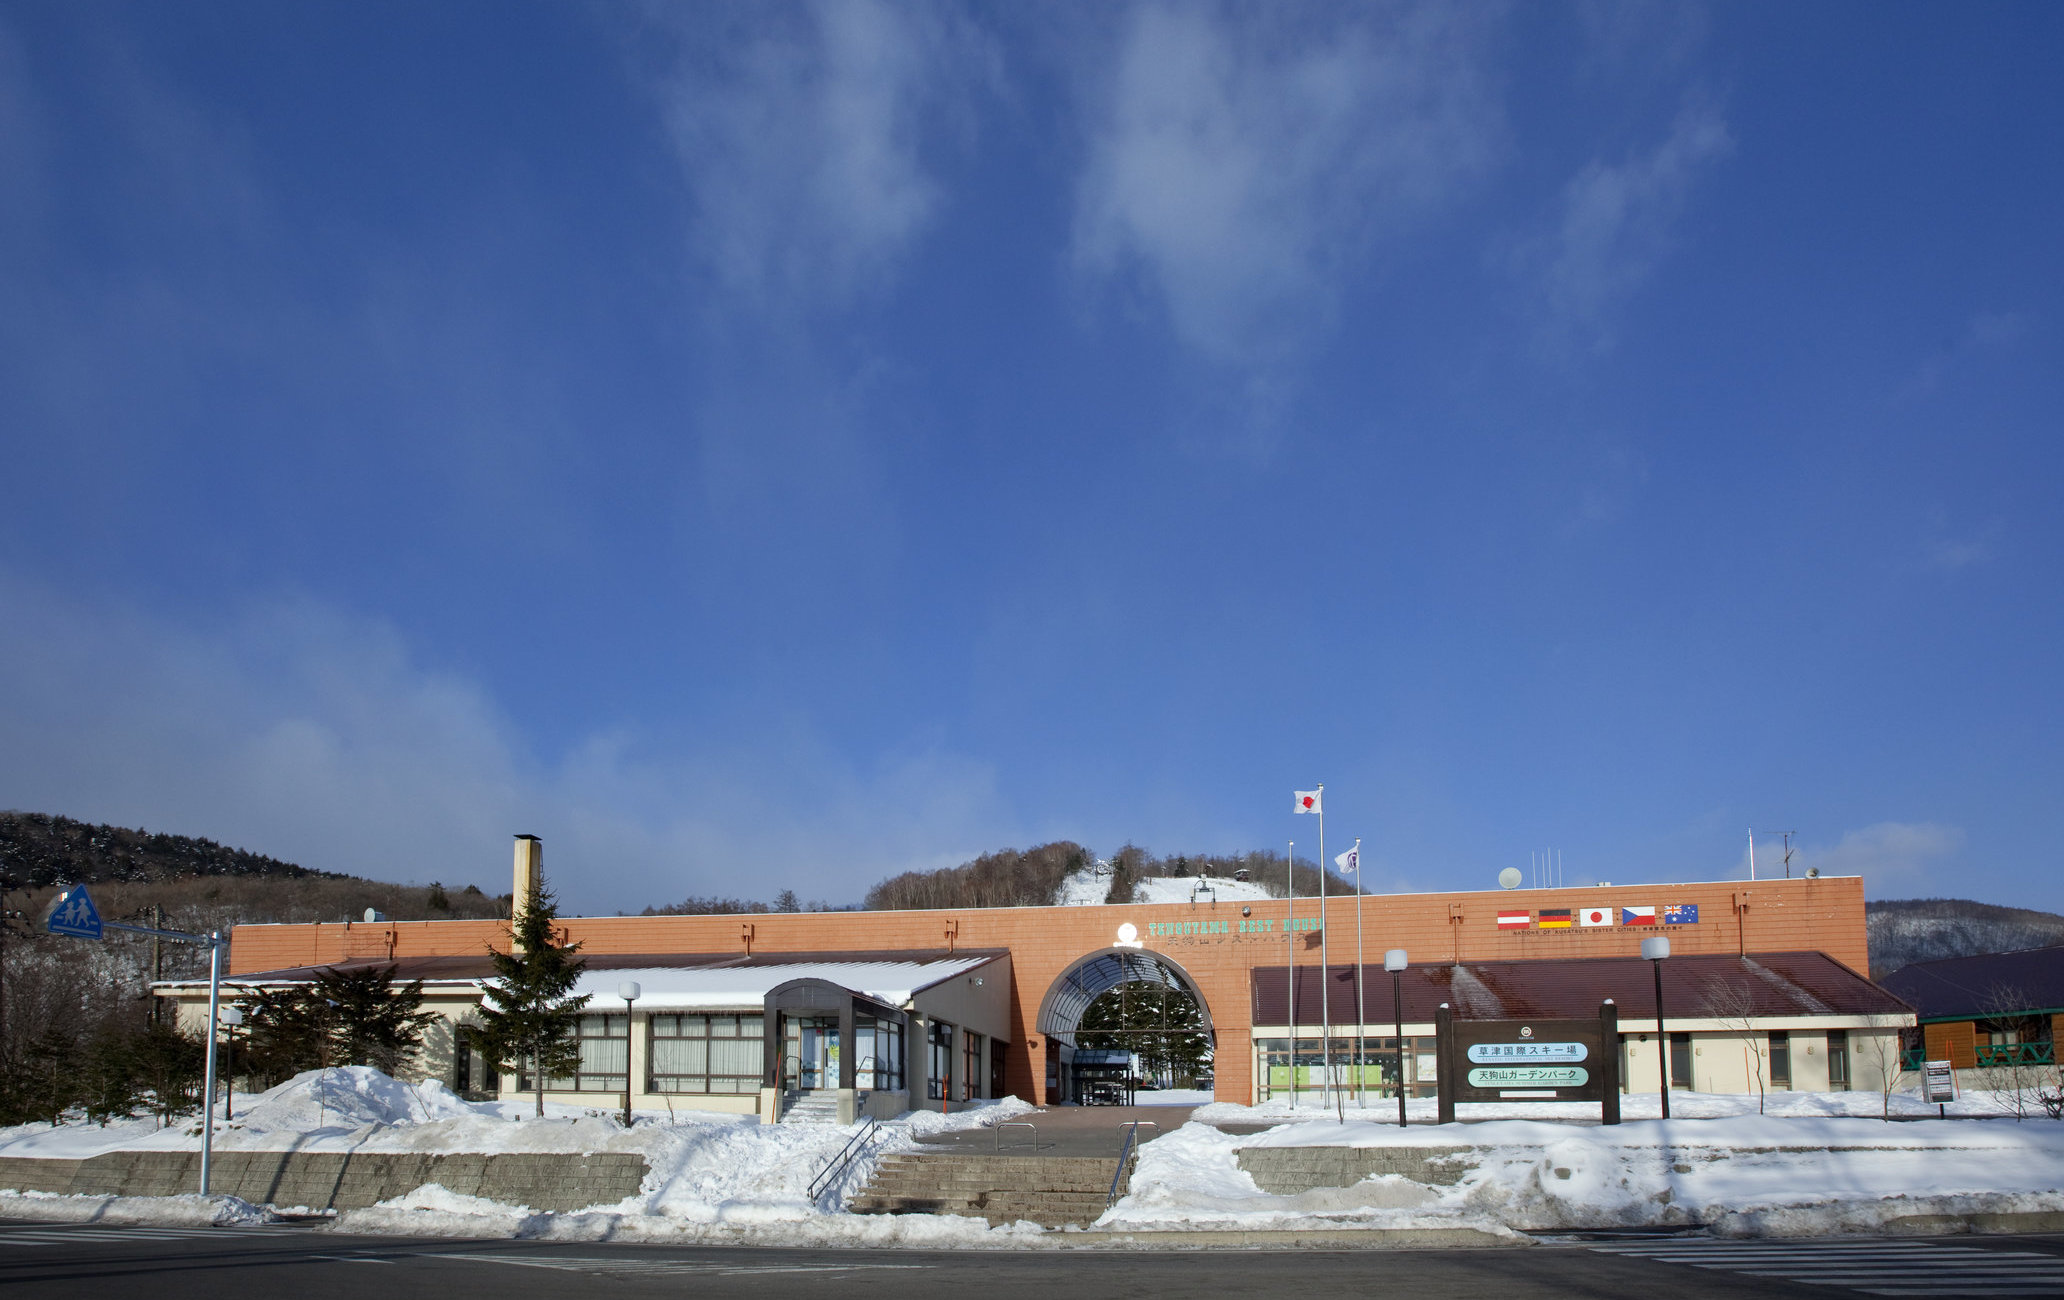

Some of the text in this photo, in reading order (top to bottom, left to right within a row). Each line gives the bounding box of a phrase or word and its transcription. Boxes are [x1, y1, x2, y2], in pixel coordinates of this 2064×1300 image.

[1149, 921, 1229, 936] TENGUYAMA
[1239, 919, 1273, 933] REST
[1478, 1045, 1577, 1056] 草津国際スキー場
